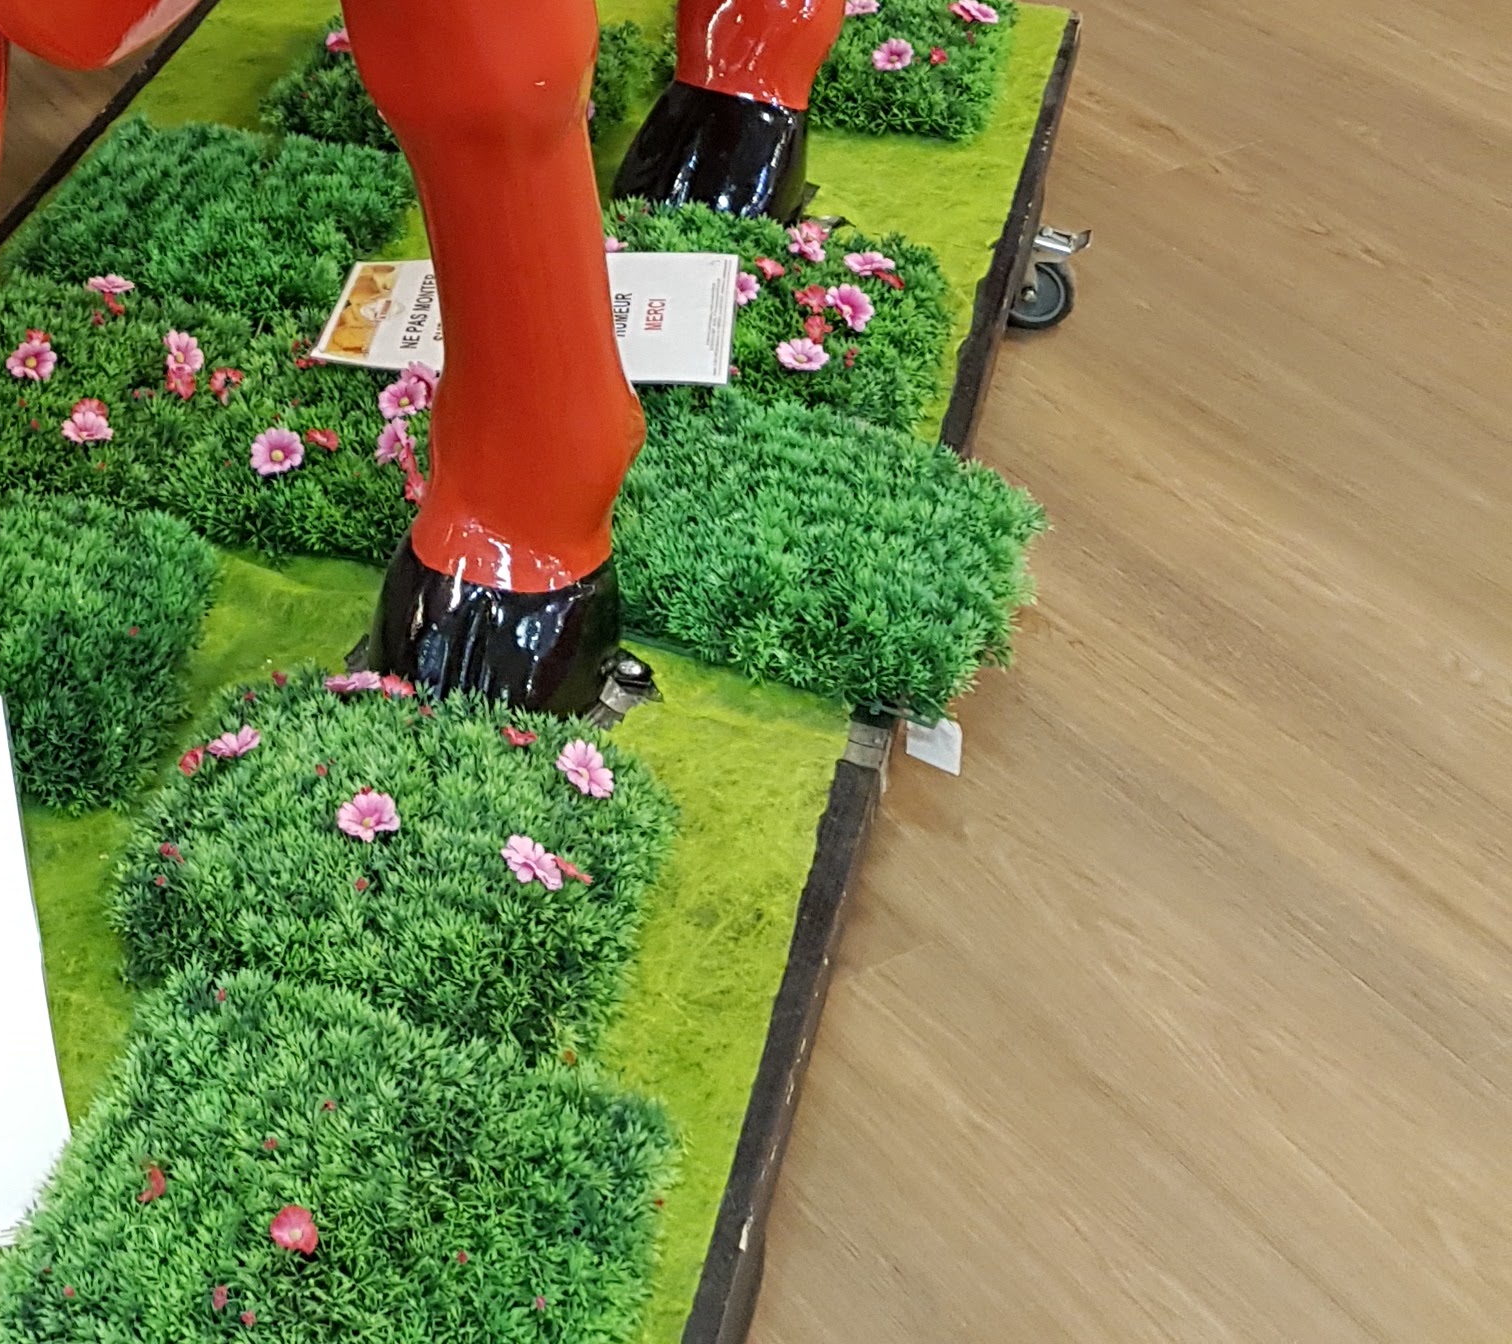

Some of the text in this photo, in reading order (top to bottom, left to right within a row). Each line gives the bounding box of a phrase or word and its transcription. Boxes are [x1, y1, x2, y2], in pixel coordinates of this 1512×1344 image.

[405, 313, 428, 333] PAS
[644, 298, 666, 330] MERCI
[400, 334, 421, 349] NE
